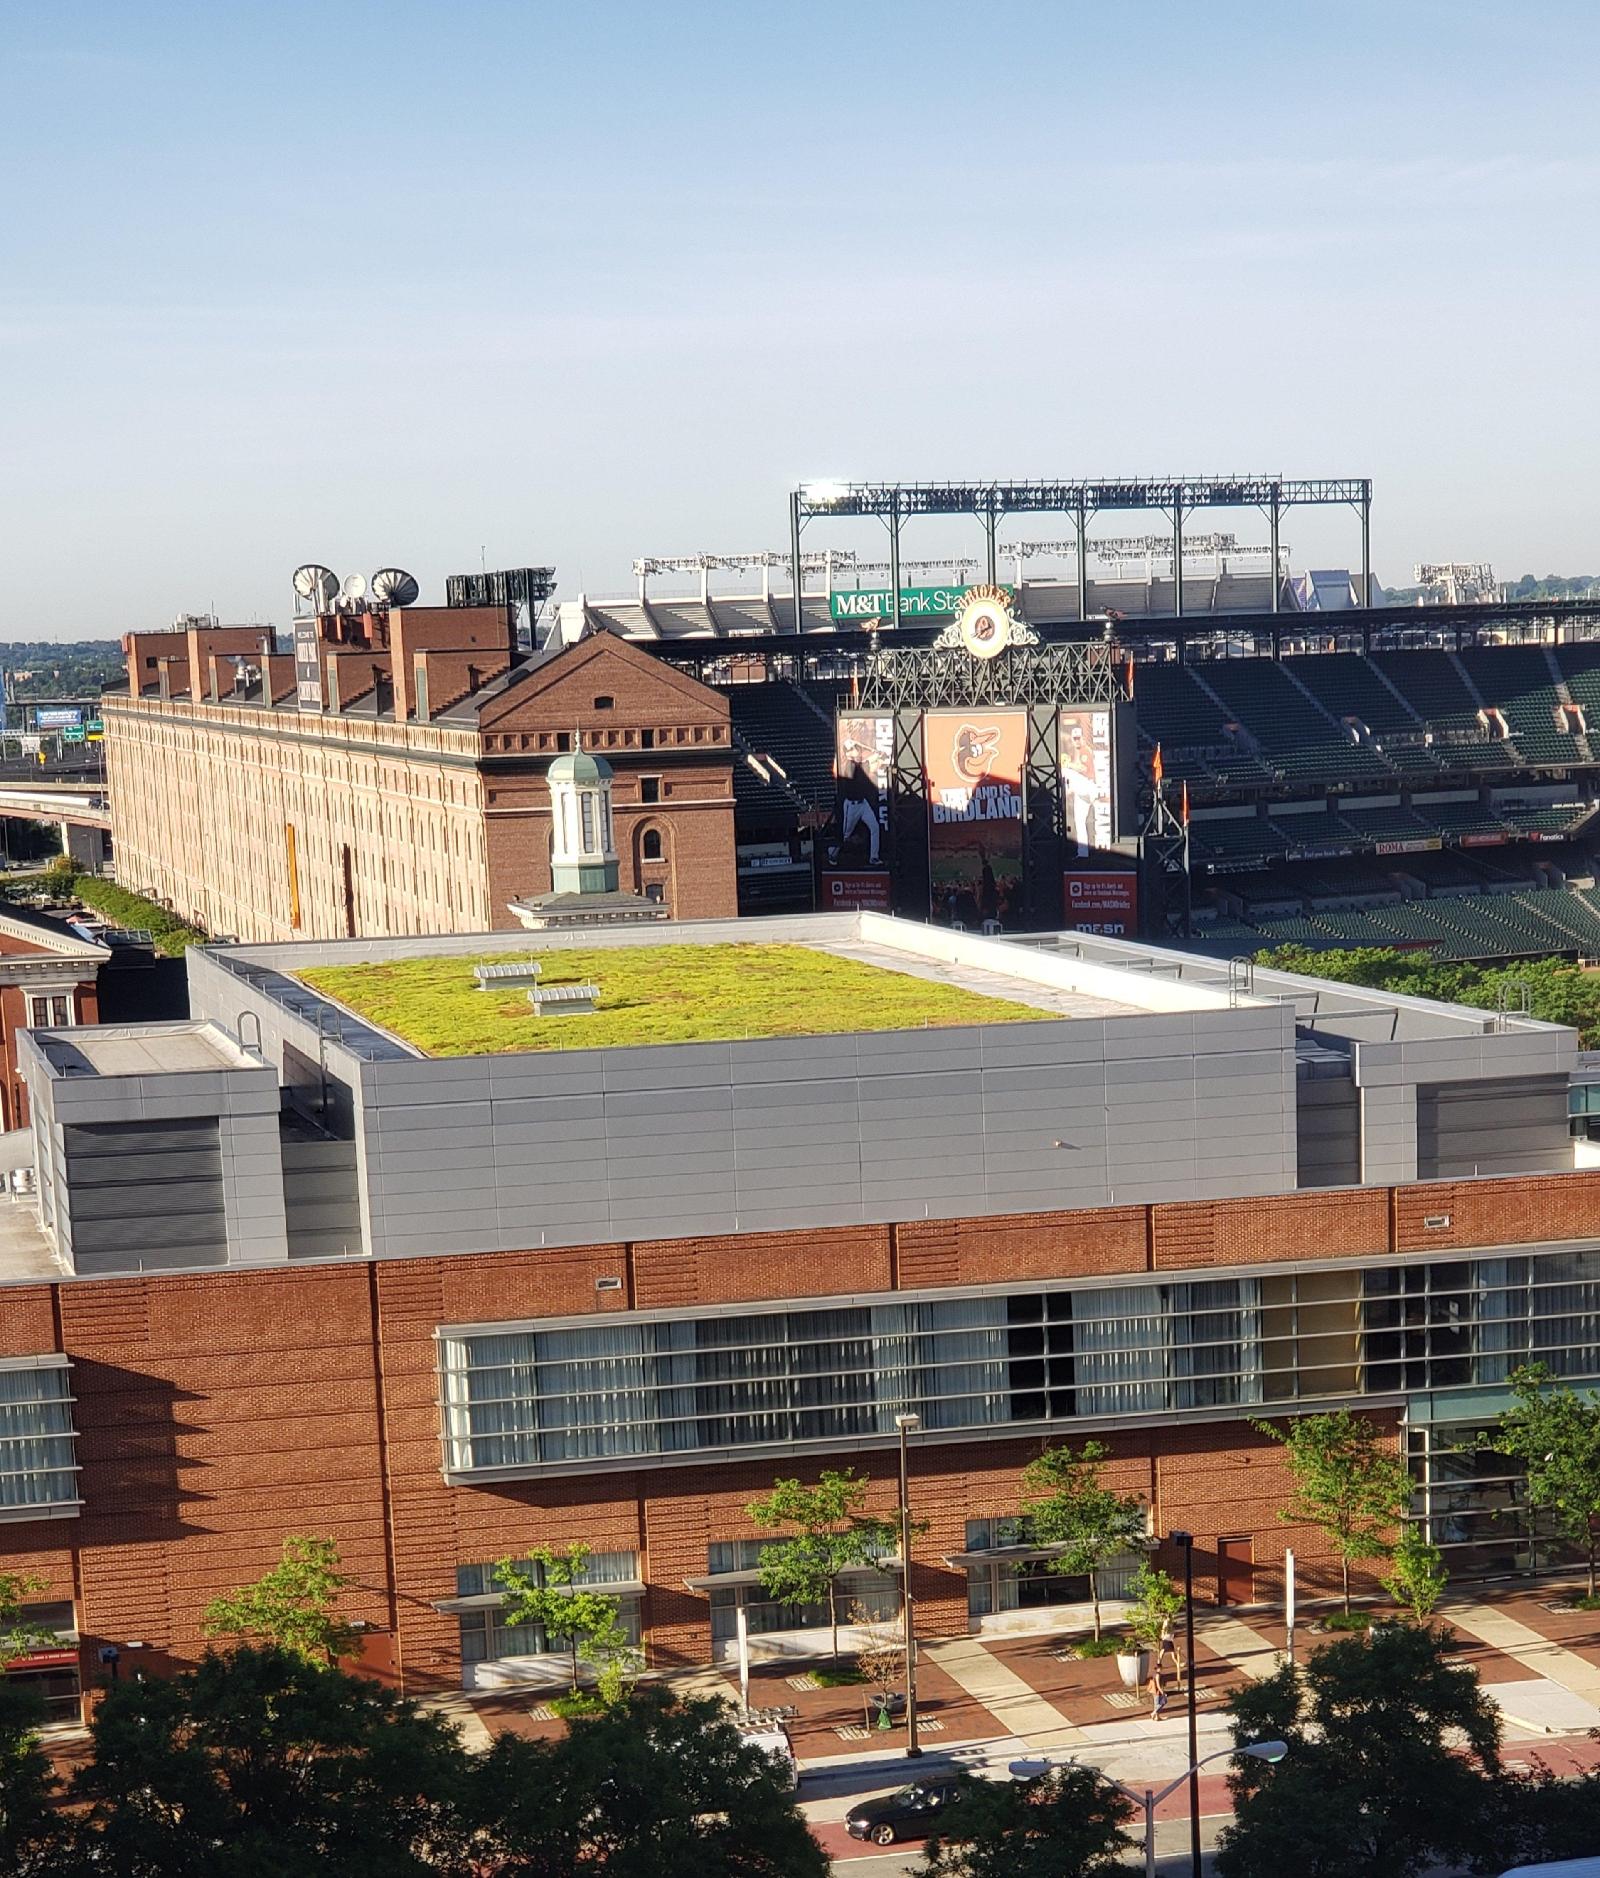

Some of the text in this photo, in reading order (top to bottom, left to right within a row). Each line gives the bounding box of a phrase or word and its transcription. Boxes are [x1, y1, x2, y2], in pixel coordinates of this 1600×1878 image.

[836, 593, 884, 615] M&T
[885, 591, 931, 613] Bank
[957, 584, 1011, 608] ORIOLES
[932, 796, 1021, 823] BIRDLAND
[1379, 842, 1404, 854] ROMA
